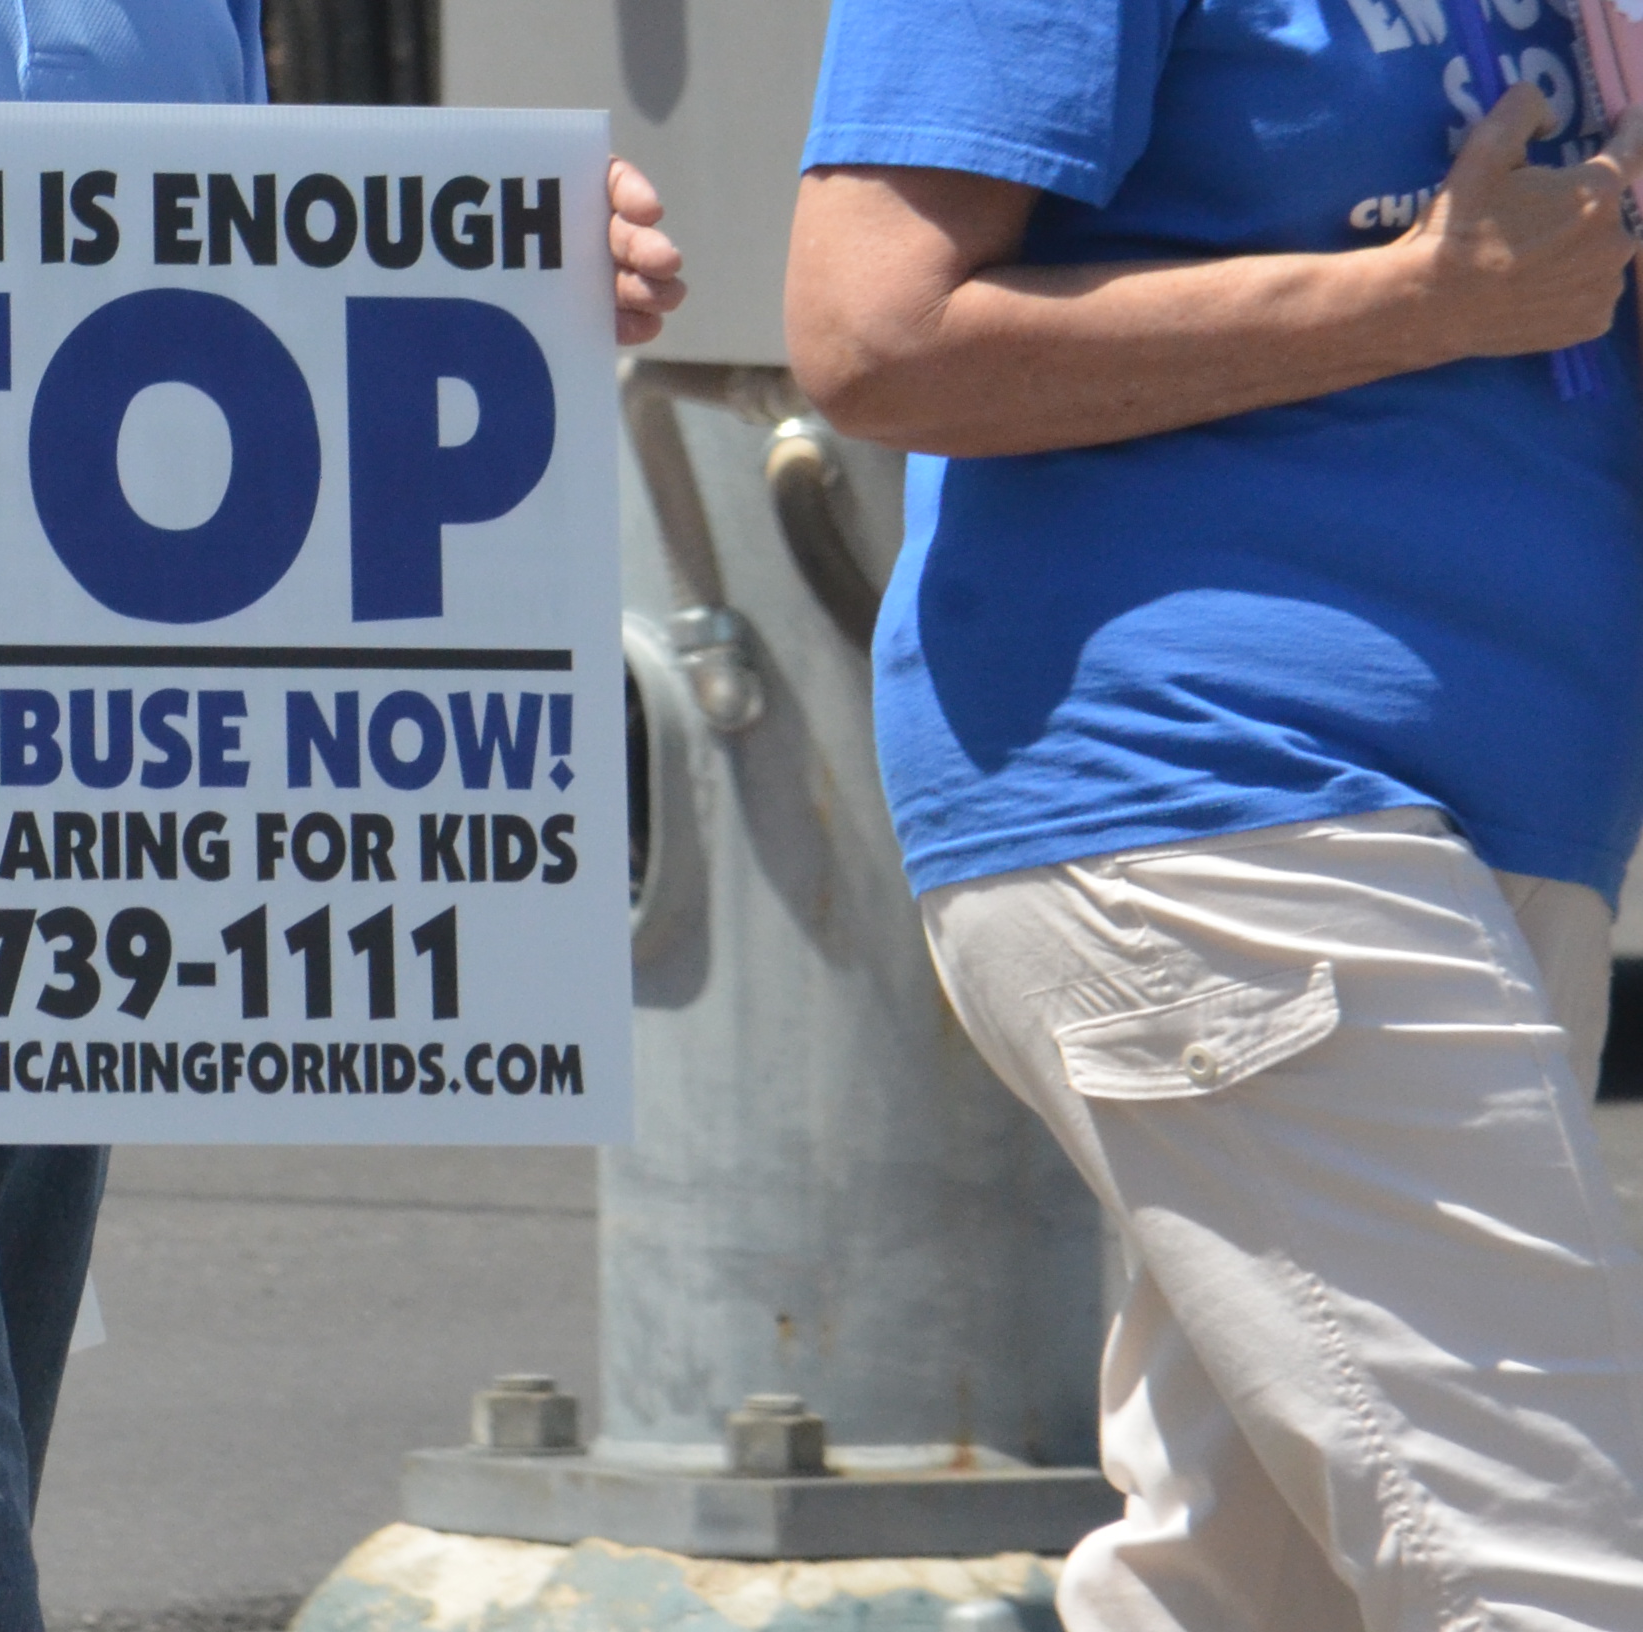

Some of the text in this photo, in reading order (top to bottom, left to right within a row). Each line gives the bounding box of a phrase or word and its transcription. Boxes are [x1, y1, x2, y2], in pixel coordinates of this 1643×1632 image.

[40, 171, 119, 266] IS
[153, 173, 562, 270] ENOUGH
[286, 690, 574, 792] NOW!
[257, 812, 396, 882] FOR
[420, 814, 577, 884] KIDS
